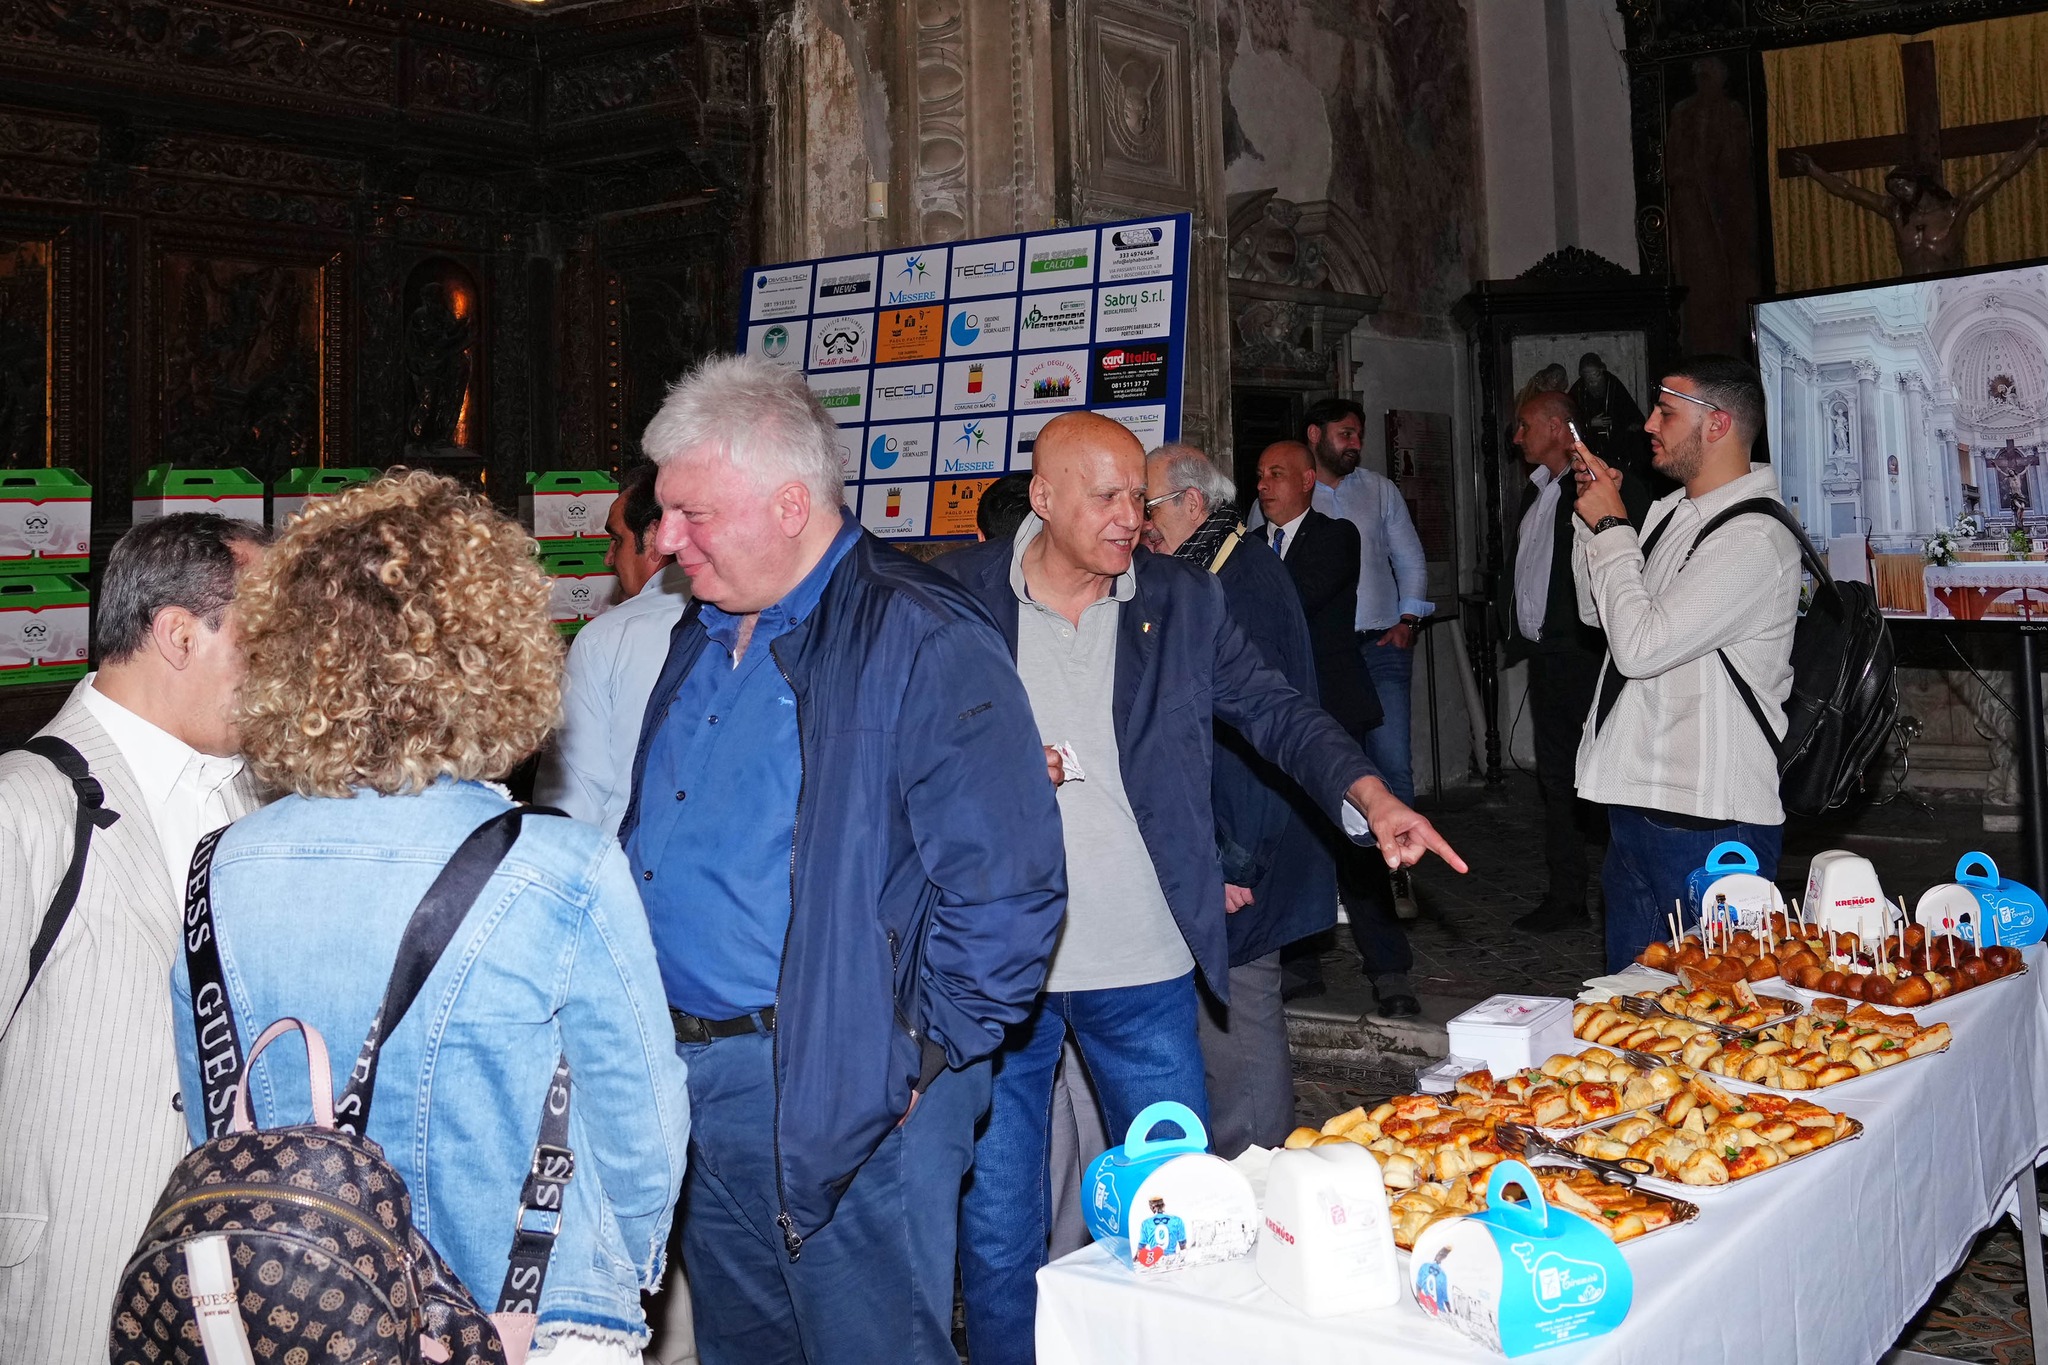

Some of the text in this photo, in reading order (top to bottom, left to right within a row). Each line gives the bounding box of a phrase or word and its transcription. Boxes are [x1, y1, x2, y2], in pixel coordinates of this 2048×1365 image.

[954, 260, 1015, 277] TECSUD
[1043, 259, 1074, 270] CALCIO
[833, 284, 857, 294] NEWS
[1104, 289, 1165, 307] Sabry S.r.l.
[1102, 352, 1124, 366] card
[1029, 364, 1045, 376] VOCE
[1066, 363, 1082, 384] ULTIMI
[875, 383, 933, 398] TECSUD
[187, 826, 222, 953] GUESS
[192, 1291, 238, 1308] GUESS
